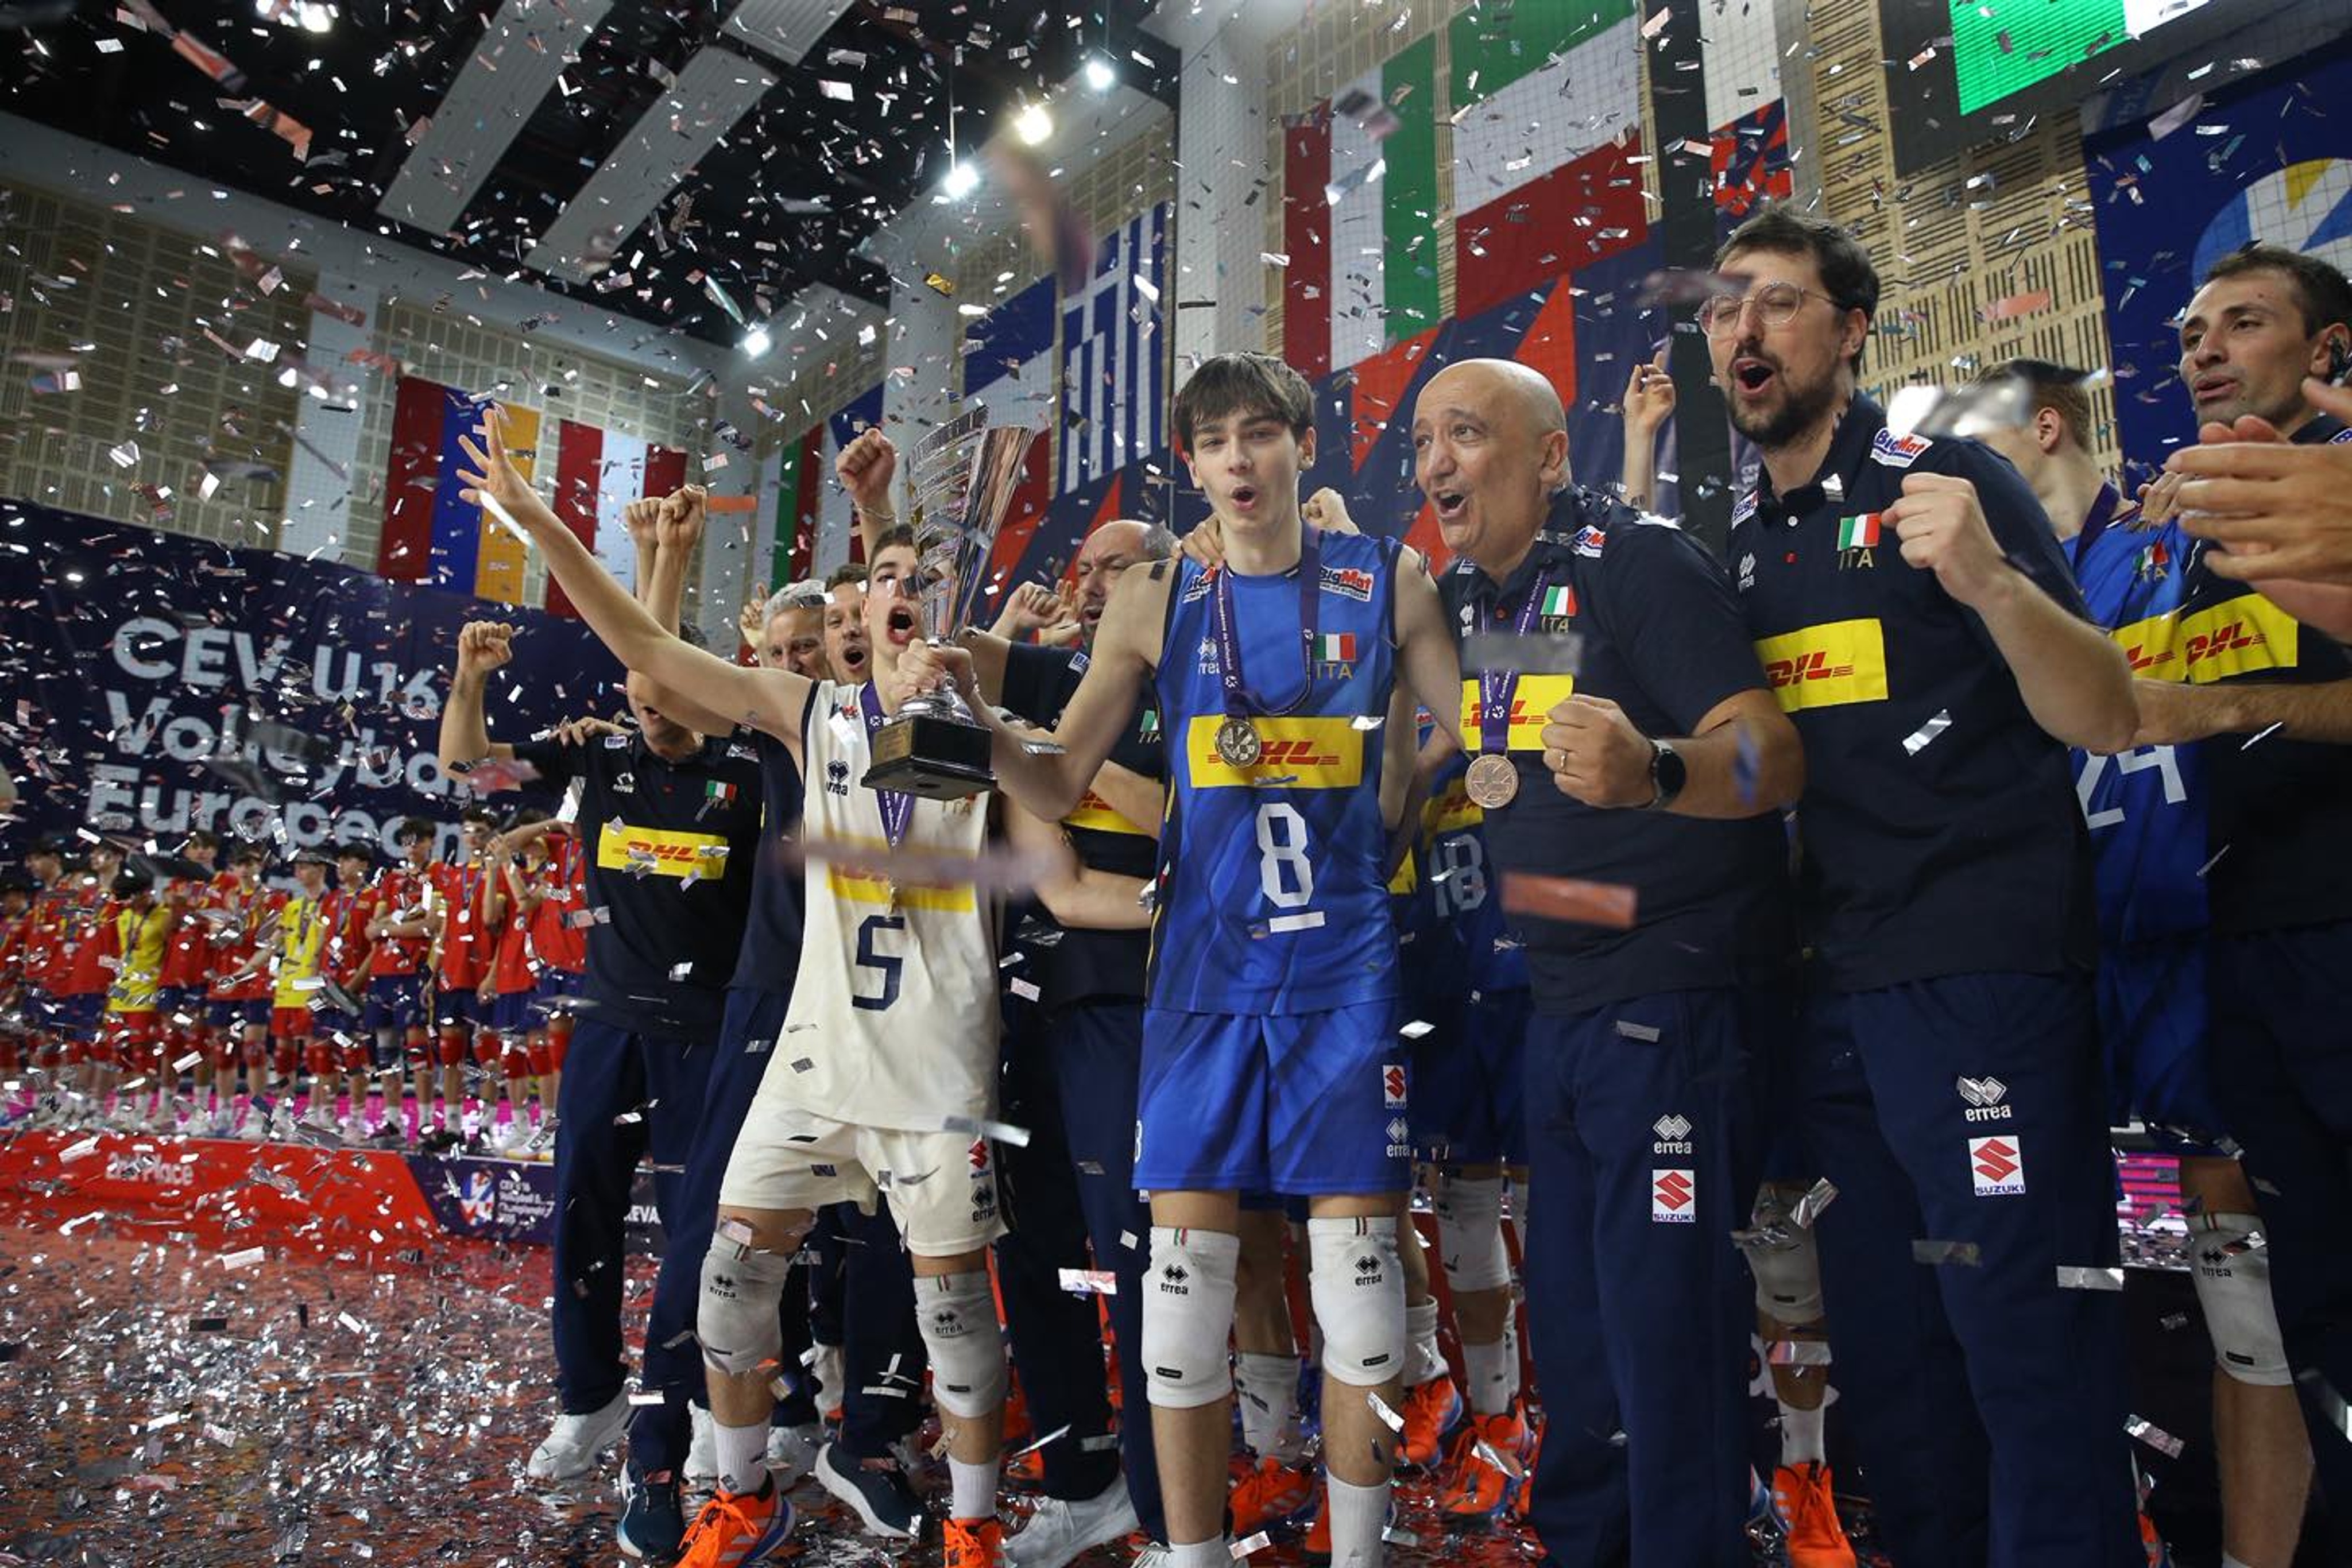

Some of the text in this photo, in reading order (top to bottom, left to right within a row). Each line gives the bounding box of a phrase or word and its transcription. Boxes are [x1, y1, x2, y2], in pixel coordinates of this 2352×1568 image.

[1839, 549, 1874, 571] ITA
[1541, 615, 1569, 634] ITA
[2185, 621, 2254, 667] DHL
[113, 616, 439, 720] CEV U16
[1316, 663, 1353, 680] ITA
[1765, 651, 1833, 688] DHL
[2068, 744, 2188, 830] 24
[1256, 802, 1314, 908] 8
[1429, 833, 1487, 917] 18
[852, 915, 905, 1011] 5
[1965, 1105, 2012, 1122] errea
[1653, 1141, 1692, 1155] errea
[1975, 1184, 2025, 1194] SUZUKI
[1653, 1213, 1695, 1221] SUZUKI
[1160, 1282, 1189, 1296] errea
